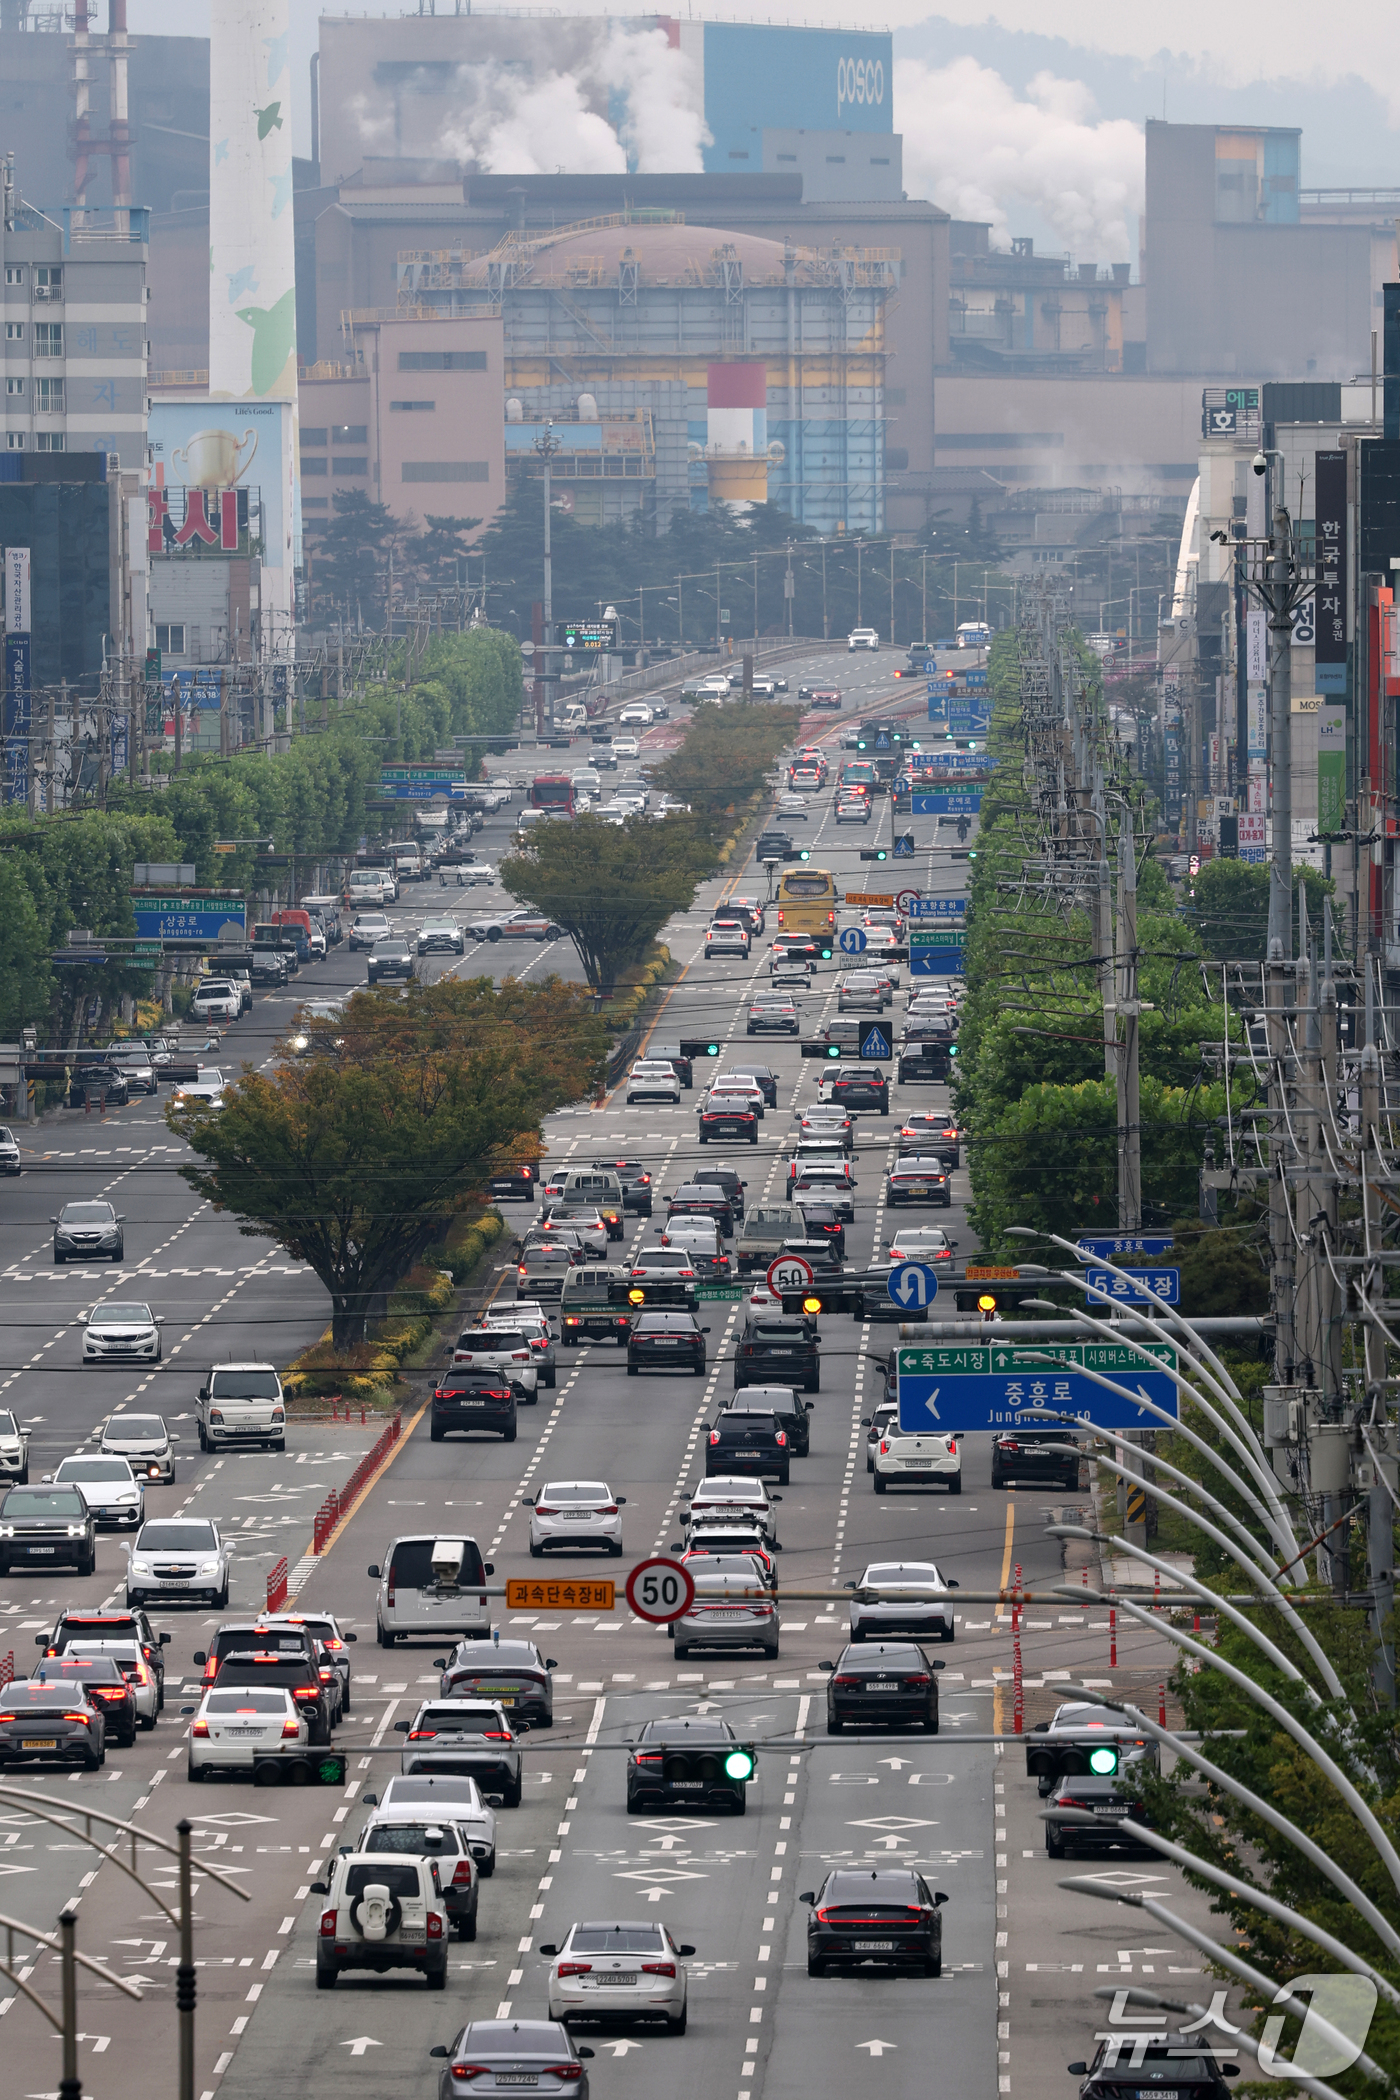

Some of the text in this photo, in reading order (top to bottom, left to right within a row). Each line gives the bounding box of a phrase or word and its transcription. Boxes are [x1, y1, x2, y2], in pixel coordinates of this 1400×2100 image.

[838, 57, 883, 118] posco
[235, 407, 274, 415] Life's Good.
[13, 563, 22, 630] 한국자산관리공사
[1332, 618, 1344, 642] 증권
[948, 797, 972, 805] 문예로
[920, 901, 957, 910] 포항운하
[165, 916, 198, 927] 상공로
[158, 928, 203, 936] Sanggong-ro
[1113, 1240, 1144, 1253] 중흥로
[778, 1269, 802, 1286] 50
[921, 1352, 984, 1370] 죽도시장
[1004, 1381, 1073, 1408] 중흥로
[515, 1586, 607, 1605] 과속단속장비
[642, 1576, 679, 1606] 50
